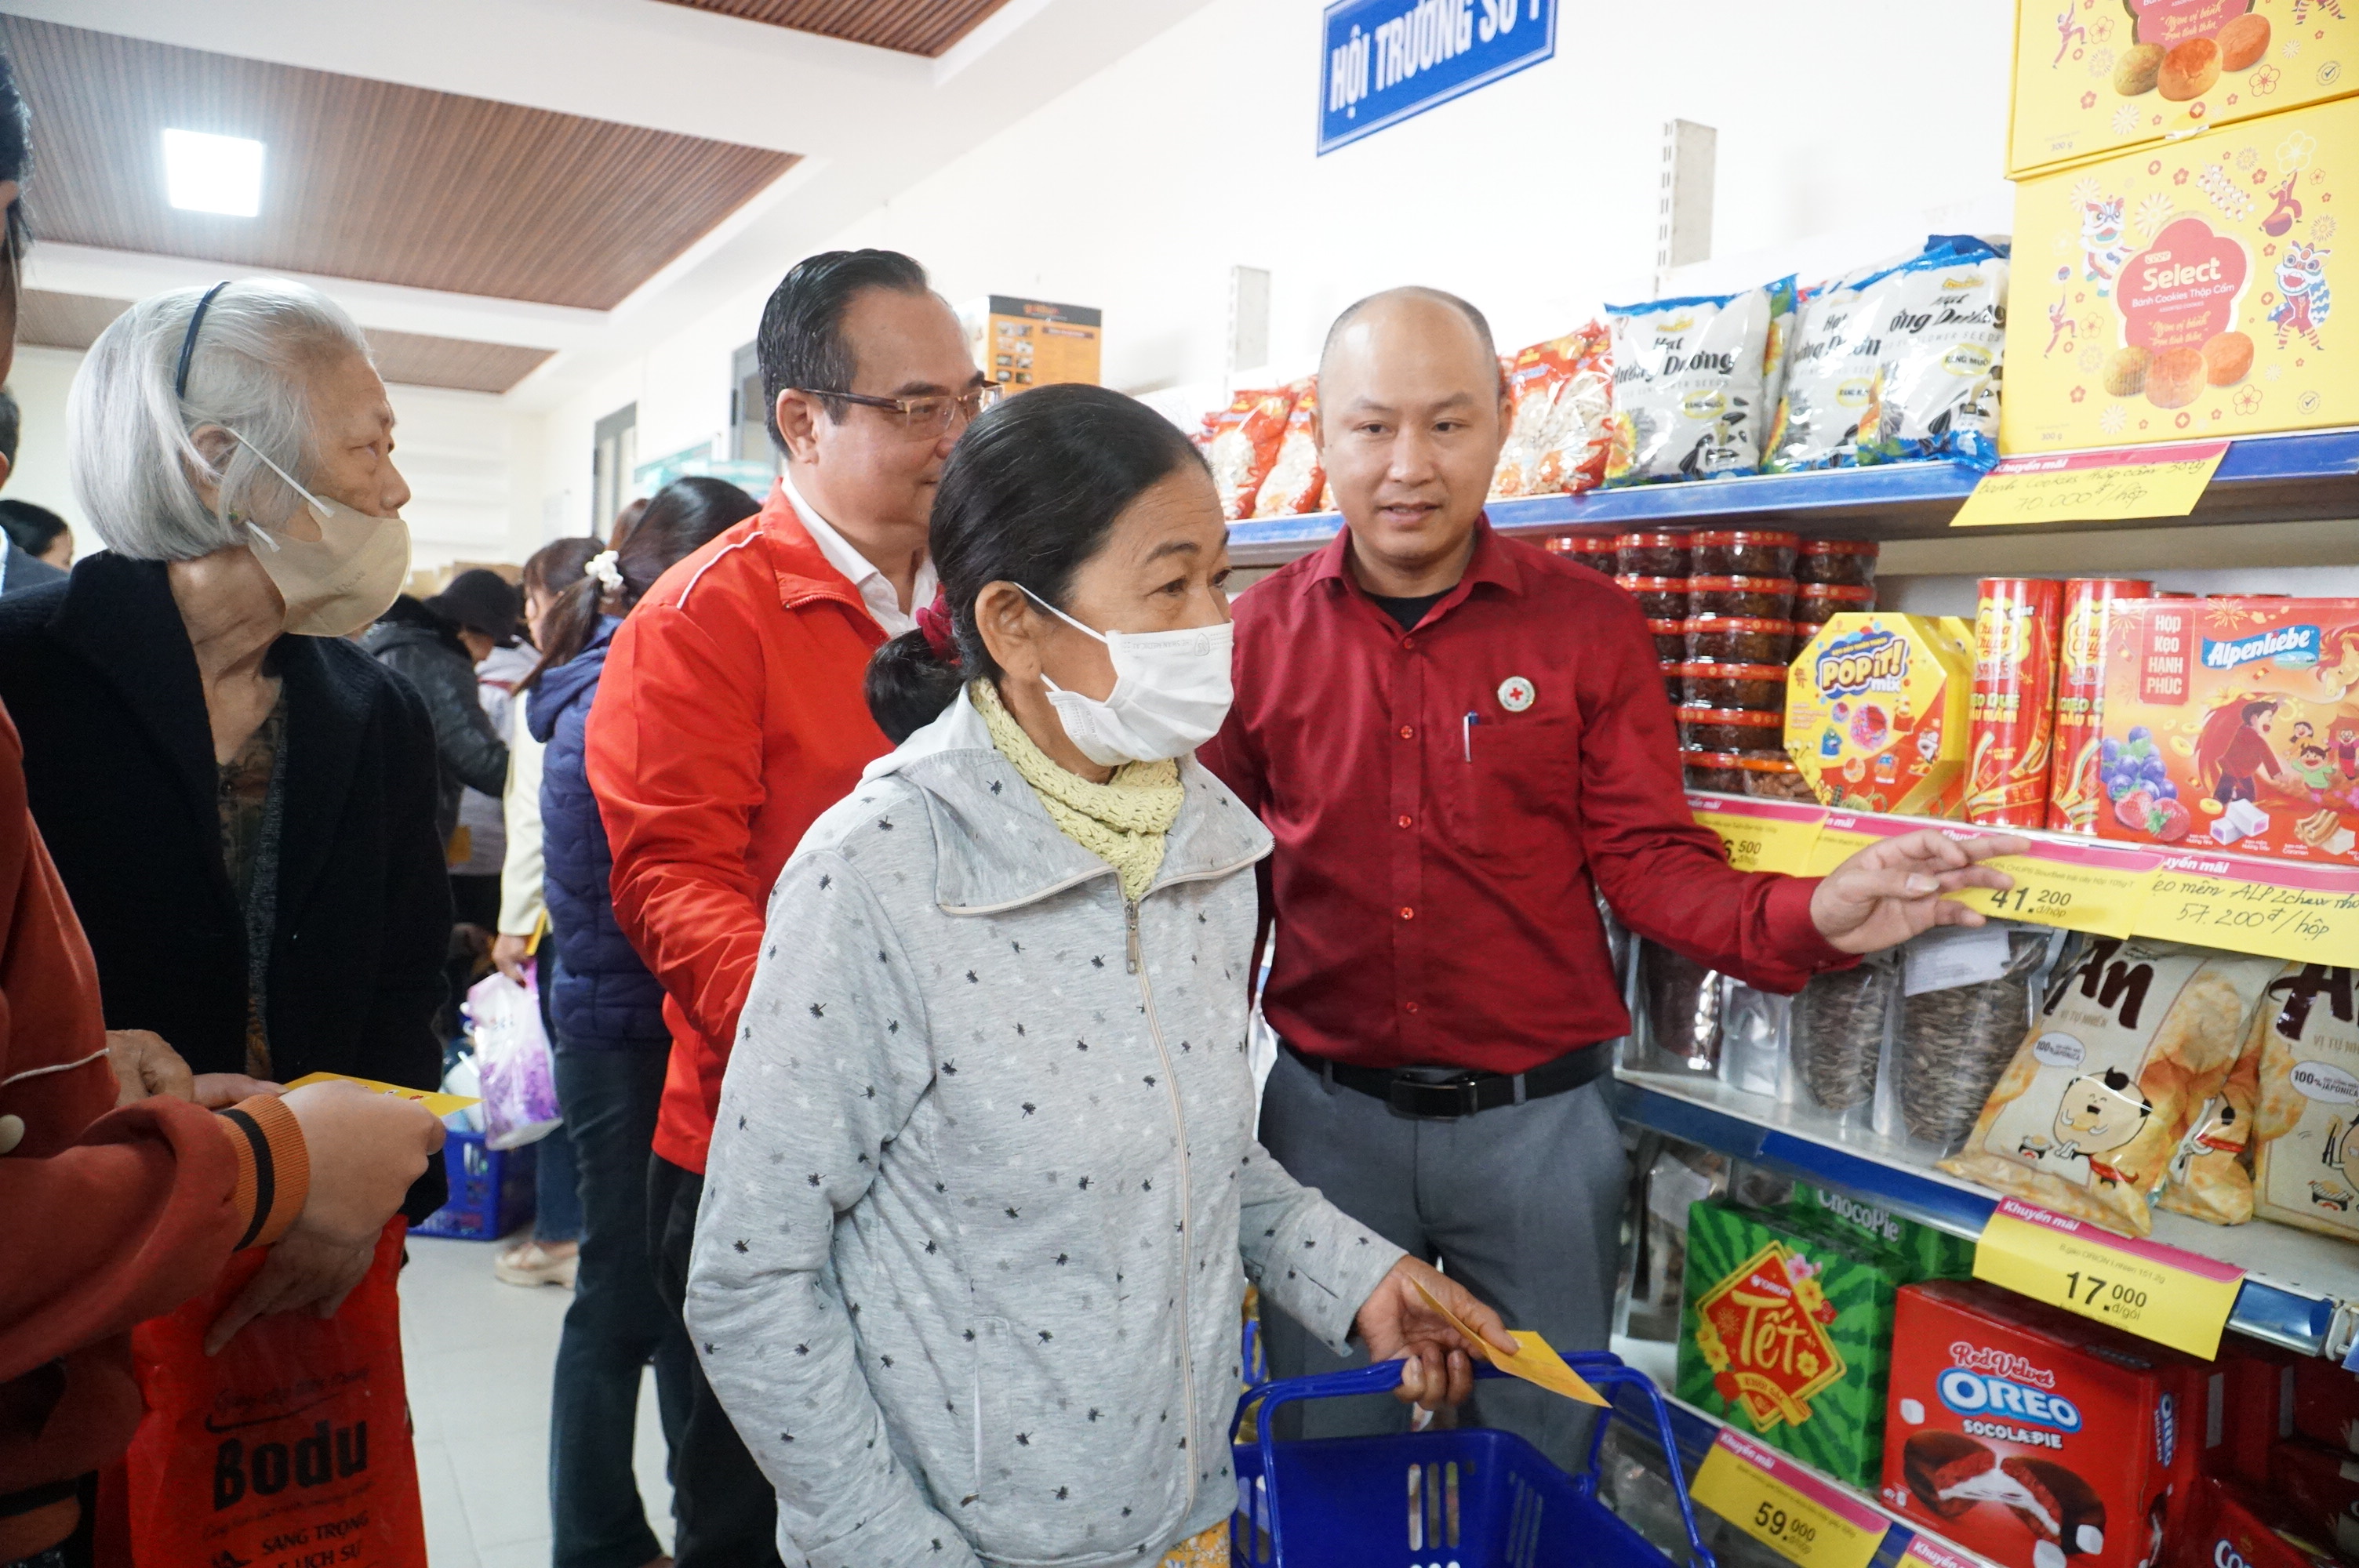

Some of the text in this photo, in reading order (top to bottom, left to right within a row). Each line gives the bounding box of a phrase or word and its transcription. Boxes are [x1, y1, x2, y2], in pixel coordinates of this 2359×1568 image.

[1329, 24, 1371, 119] HỘI
[2143, 256, 2222, 292] Select
[2154, 292, 2188, 304] Cookies
[2148, 656, 2183, 676] HẠNH
[2207, 626, 2311, 671] Alpenliebe
[1870, 674, 1902, 693] mix
[2146, 674, 2183, 695] PHÚC
[2269, 963, 2359, 1041] A
[2003, 1200, 2082, 1232] Khuyến mãi
[1731, 1289, 1808, 1376] Tết
[1949, 1341, 1994, 1370] Red
[1941, 1370, 2080, 1428] OREO
[2161, 1392, 2174, 1468] OREO
[213, 1419, 369, 1512] Bodu
[260, 1527, 310, 1556] SANG
